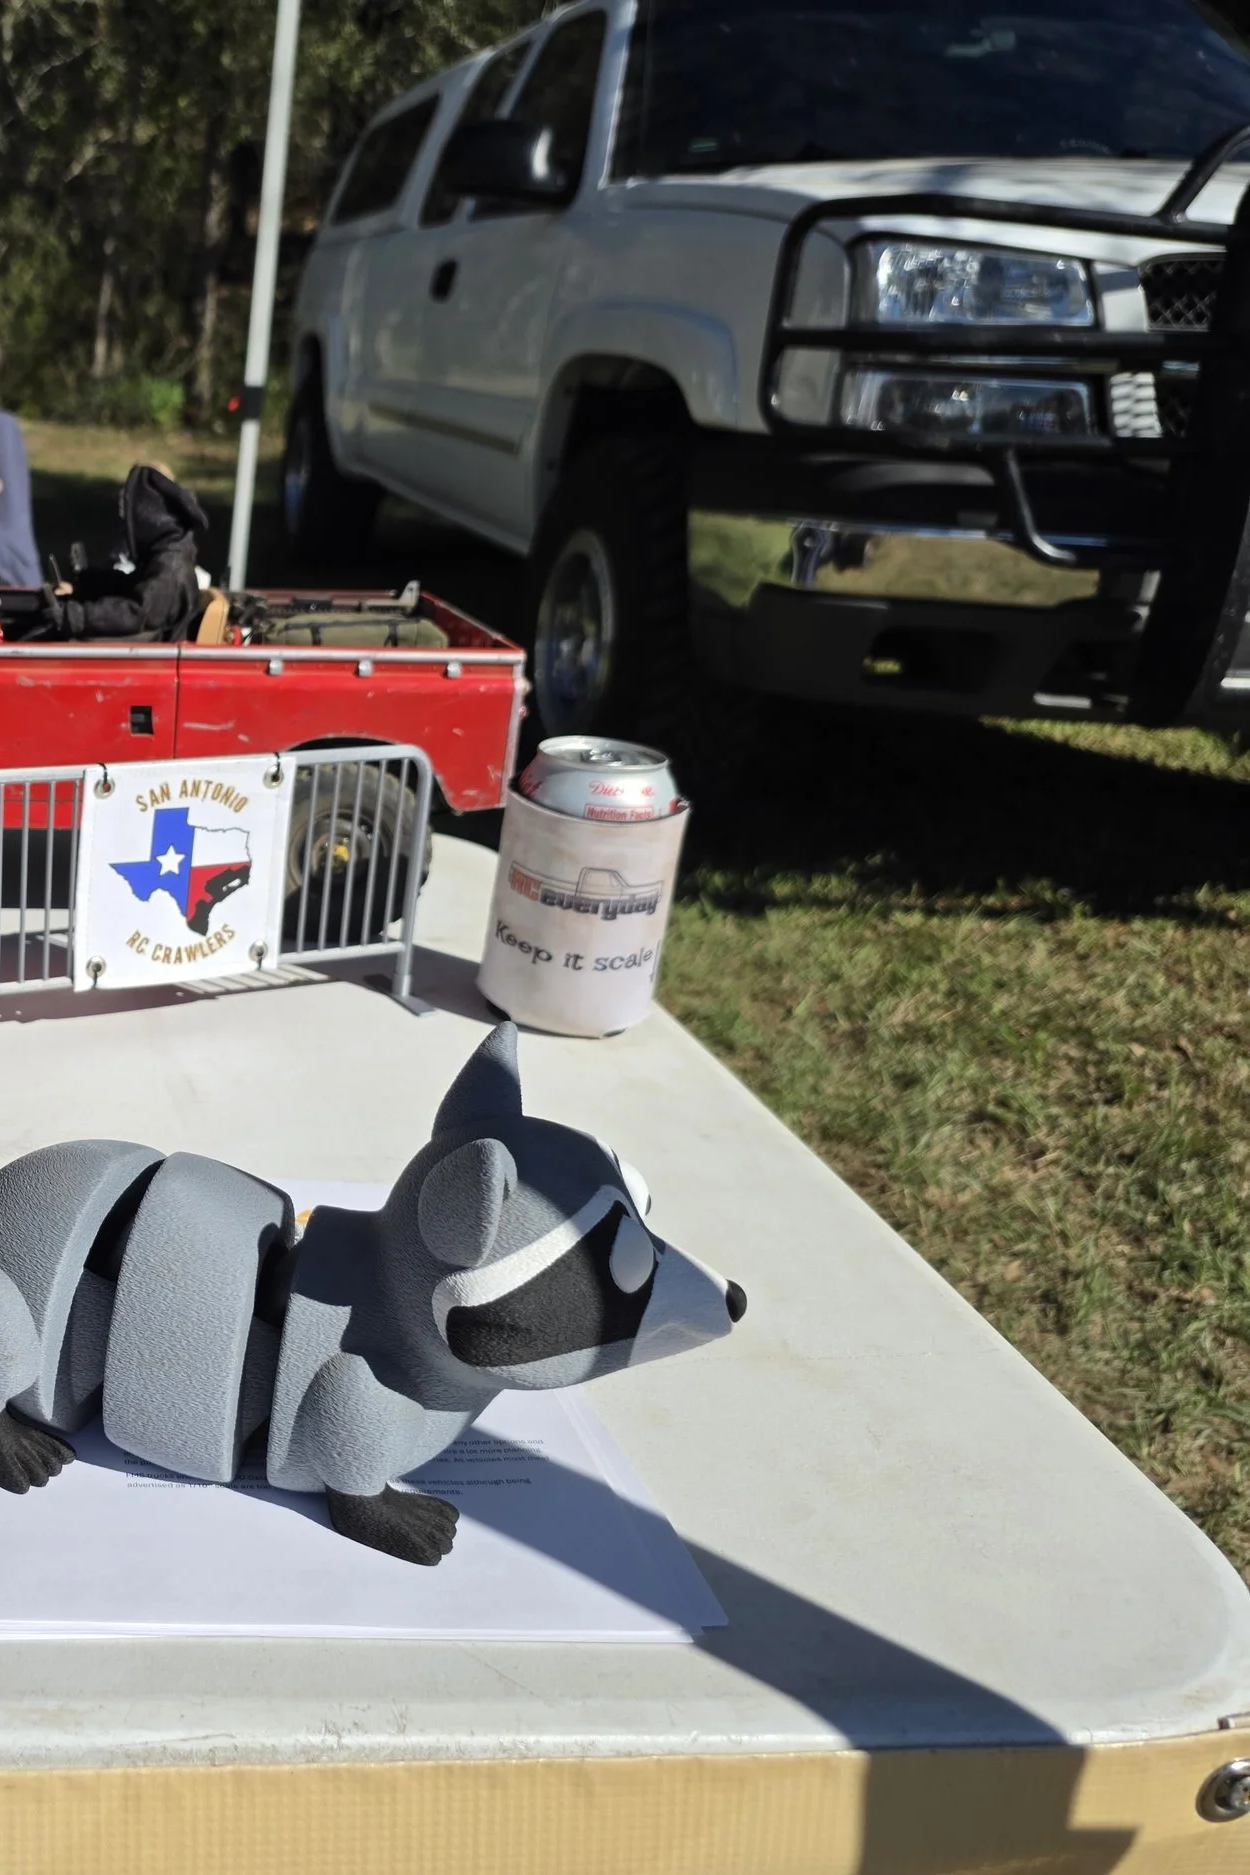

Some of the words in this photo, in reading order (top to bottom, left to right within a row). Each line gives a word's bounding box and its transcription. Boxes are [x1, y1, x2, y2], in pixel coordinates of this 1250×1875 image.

[135, 781, 171, 813] SAN
[179, 779, 249, 813] ANTONIO
[586, 808, 627, 820] Nutrition
[125, 929, 150, 954] RC
[152, 923, 235, 965] CRAWLERS
[495, 919, 553, 965] Keep
[562, 952, 585, 971] it
[592, 947, 653, 972] scale
